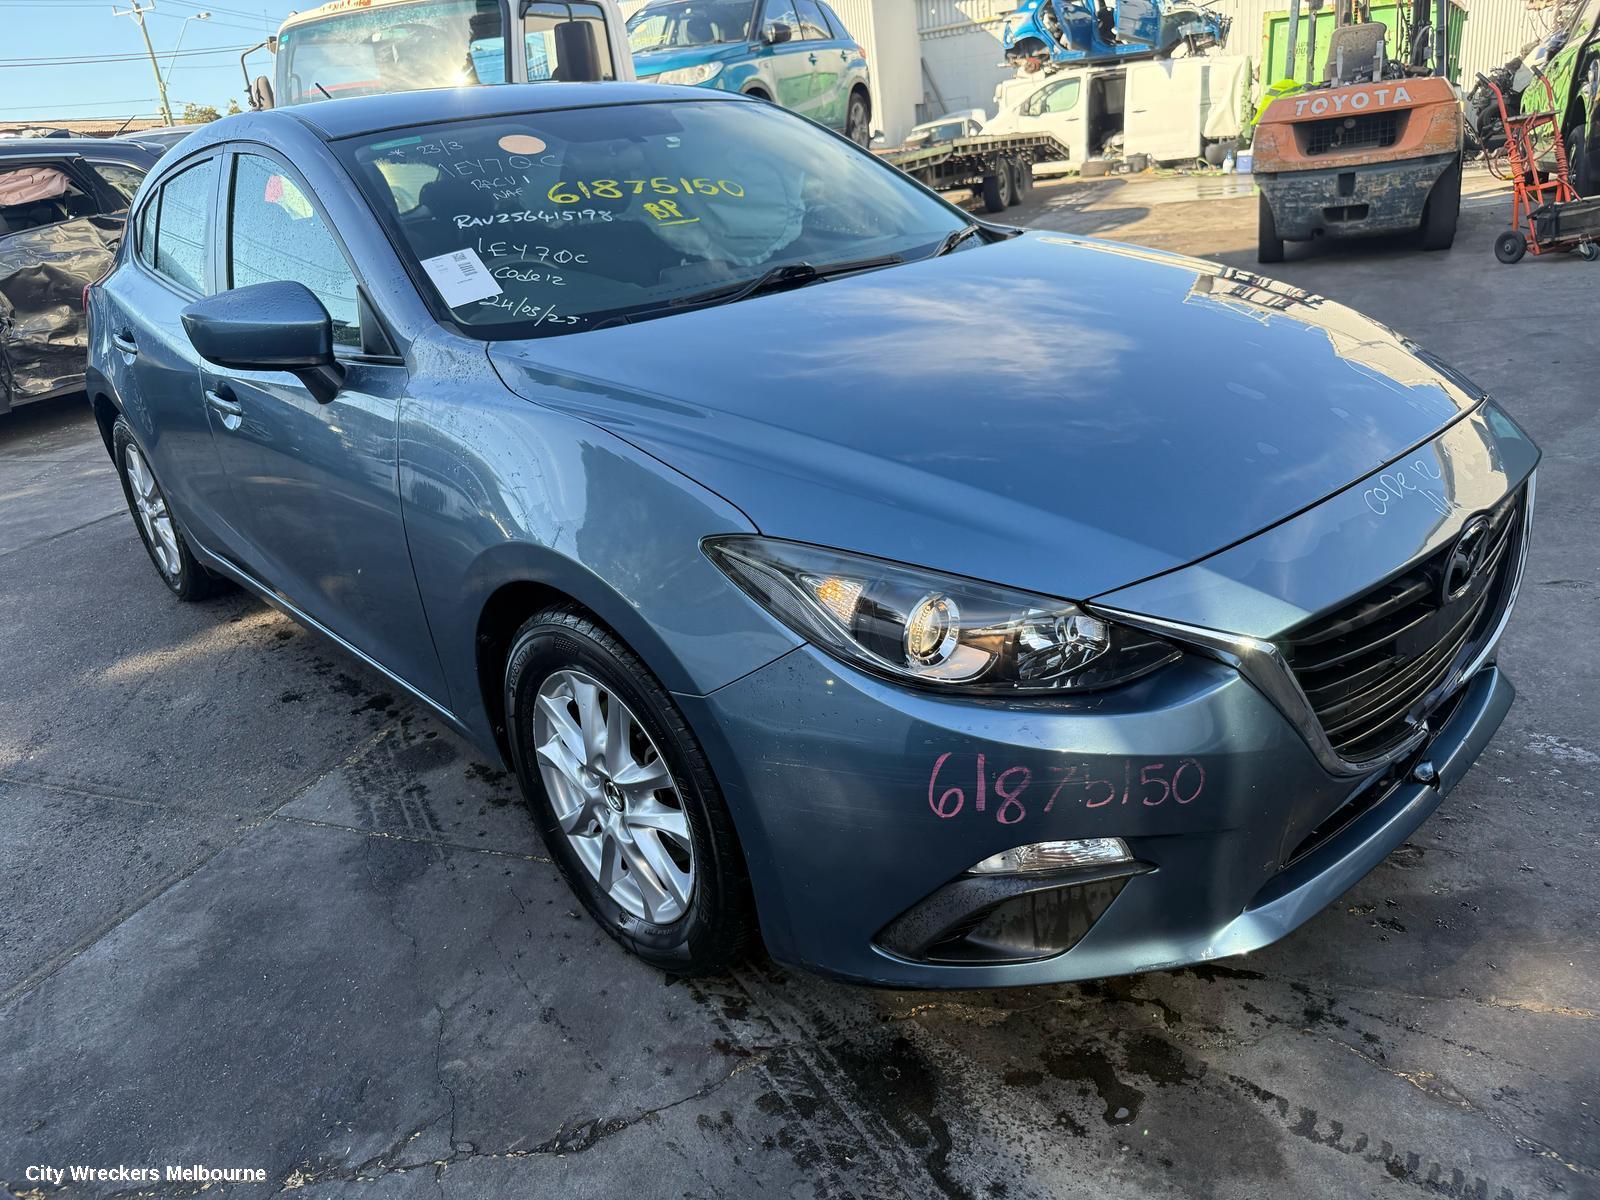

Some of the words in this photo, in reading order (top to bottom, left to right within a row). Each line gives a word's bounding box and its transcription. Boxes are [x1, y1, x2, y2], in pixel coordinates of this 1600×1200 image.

[1296, 87, 1412, 117] TOYOTA
[548, 177, 744, 204] 61875150
[928, 752, 1206, 824] 61875150
